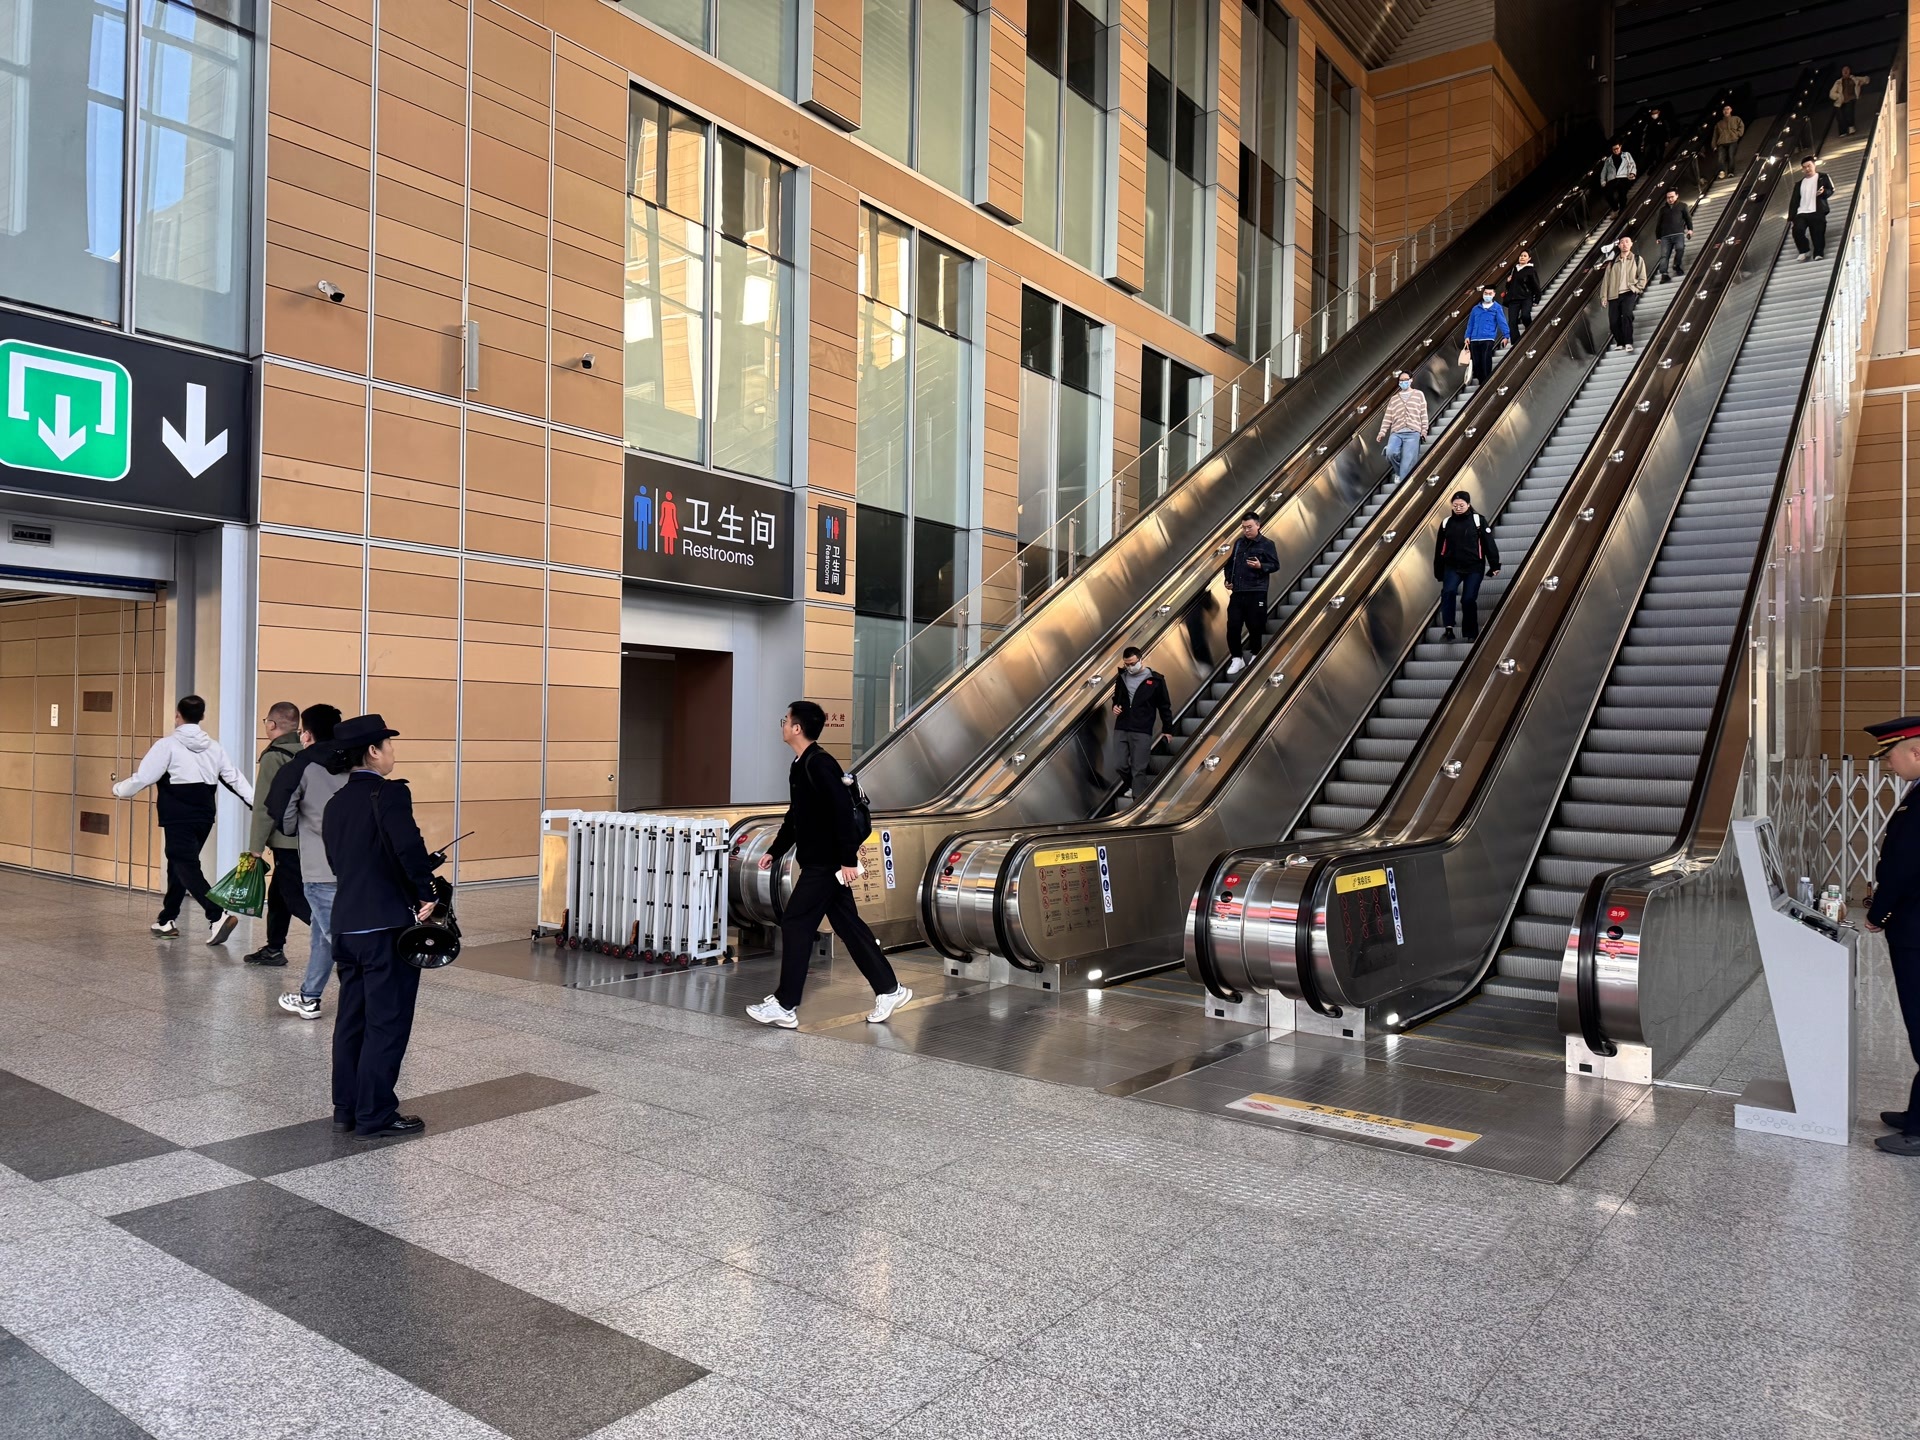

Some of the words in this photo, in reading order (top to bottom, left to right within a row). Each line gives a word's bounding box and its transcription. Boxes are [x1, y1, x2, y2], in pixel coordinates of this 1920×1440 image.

[683, 497, 775, 549] 卫生间
[682, 538, 754, 567] Restrooms
[824, 544, 832, 585] Restrooms
[831, 545, 841, 586] 卫生间
